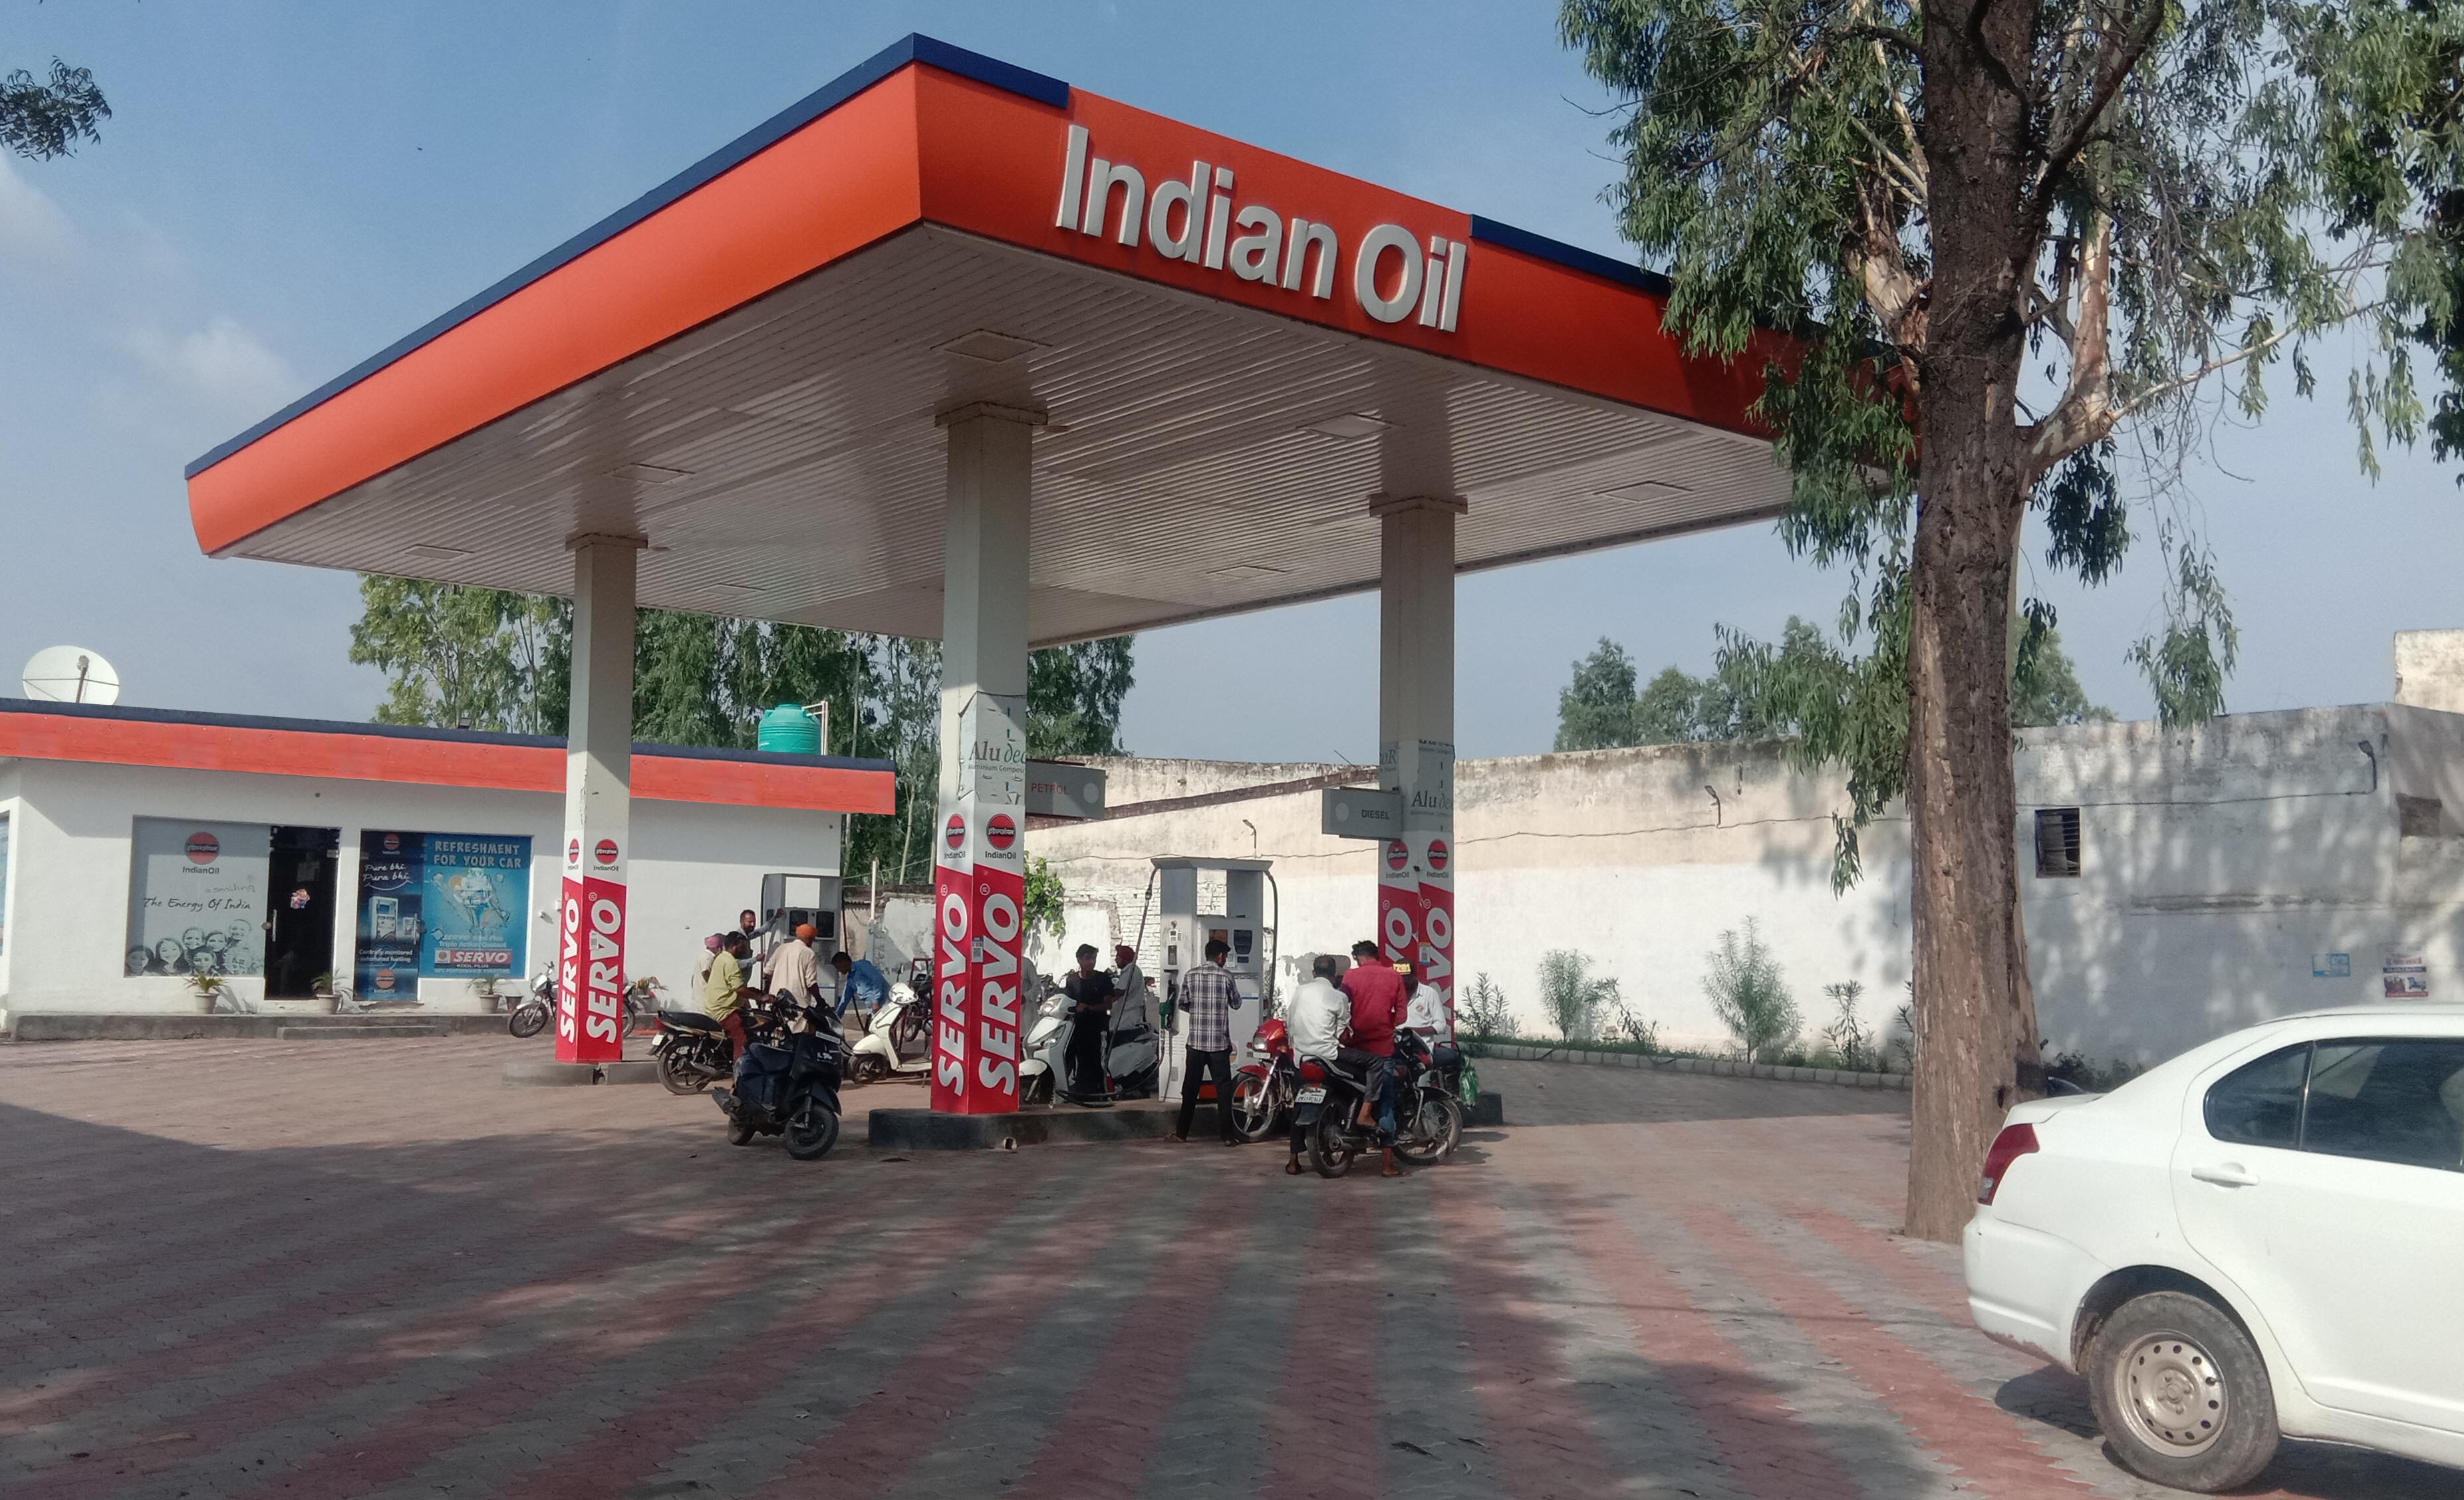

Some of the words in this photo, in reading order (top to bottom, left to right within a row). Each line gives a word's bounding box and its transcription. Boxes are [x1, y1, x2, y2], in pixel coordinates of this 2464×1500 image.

[1055, 124, 1338, 299] Indian
[1354, 223, 1466, 332] Oil
[1031, 783, 1069, 796] PETROL
[1361, 809, 1391, 820] DIESEL
[434, 840, 520, 856] REFRESHMENT
[985, 850, 1017, 860] IndianOil
[434, 854, 456, 865] FOR
[463, 856, 495, 867] YOUR
[499, 857, 522, 868] CAR
[182, 866, 220, 875] IndianOil
[143, 896, 163, 908] The
[168, 898, 204, 912] Energy
[207, 898, 223, 911] Of
[223, 898, 251, 910] India
[453, 951, 509, 963] SERVO
[560, 898, 579, 1044] SERVO
[586, 899, 621, 1044] SERVO
[938, 893, 968, 1096] SERVO
[978, 893, 1020, 1096] SERVO
